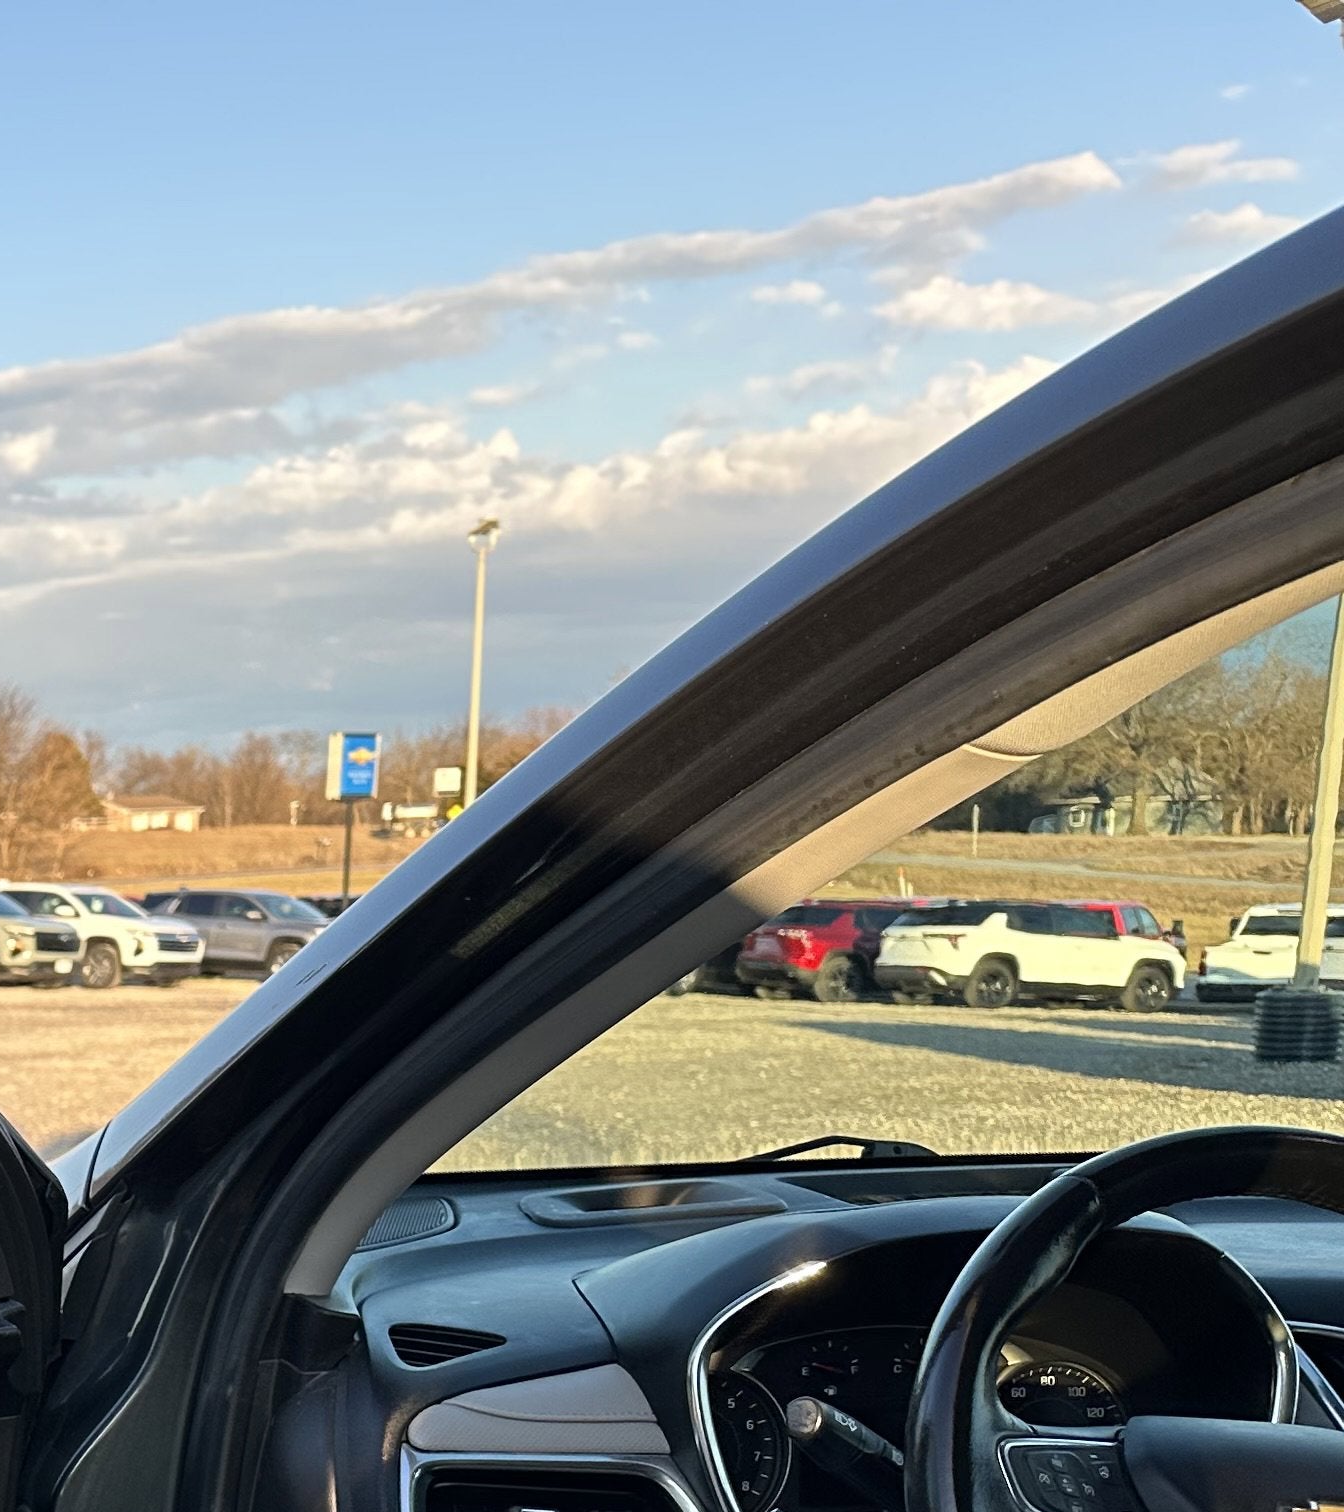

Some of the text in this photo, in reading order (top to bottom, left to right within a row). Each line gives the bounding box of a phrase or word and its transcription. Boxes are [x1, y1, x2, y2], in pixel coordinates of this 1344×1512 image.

[801, 1365, 859, 1376] E F
[1040, 1375, 1056, 1386] 80
[1068, 1386, 1086, 1397] 100
[727, 1398, 736, 1409] 5
[1086, 1407, 1105, 1418] 120
[746, 1420, 755, 1430] 6
[753, 1451, 761, 1462] 7
[742, 1481, 750, 1491] 8
